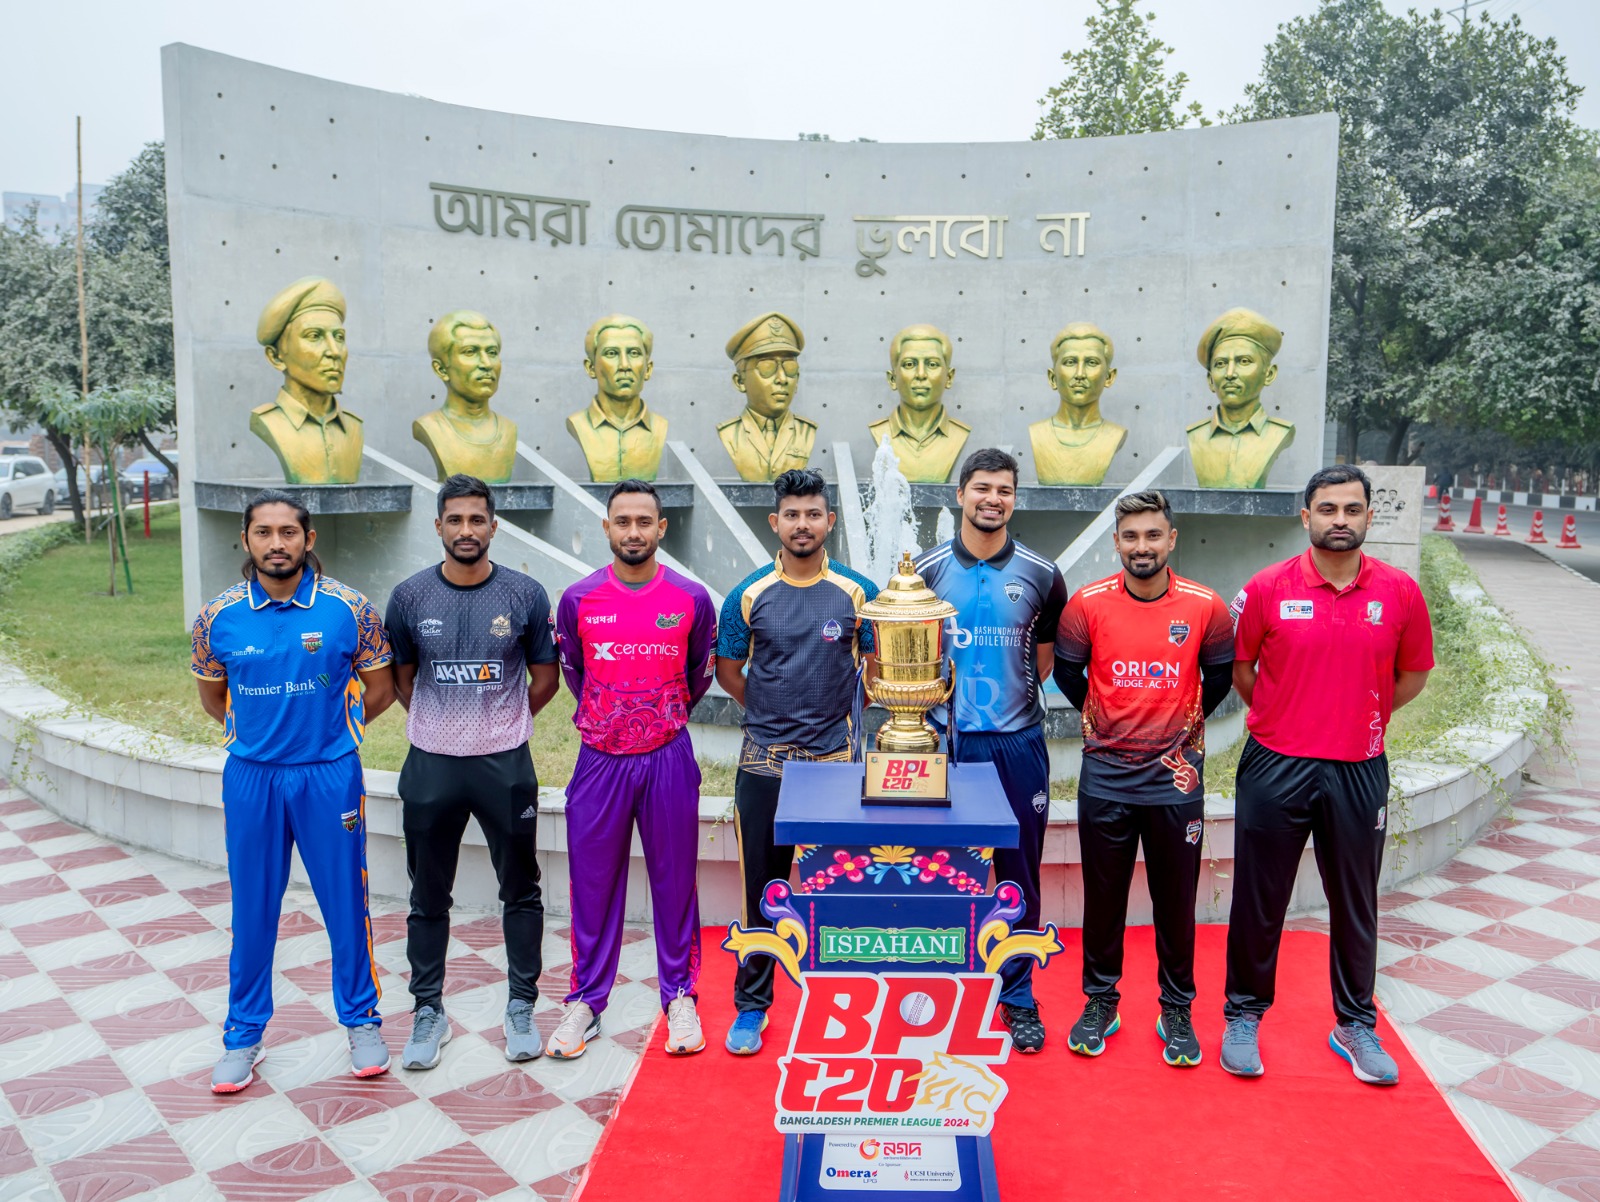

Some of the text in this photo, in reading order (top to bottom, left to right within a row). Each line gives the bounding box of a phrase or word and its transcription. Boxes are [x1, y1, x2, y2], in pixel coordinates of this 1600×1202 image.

[429, 182, 1090, 277] আমরা তোমাদের ভুলবো না
[974, 626, 1023, 636] BASHUNDHARA
[974, 635, 1021, 647] TOILETRIES
[436, 662, 501, 684] AKHTAR
[1111, 660, 1180, 677] ORION
[237, 679, 316, 696] Premier Bank
[477, 684, 503, 694] group
[885, 759, 930, 778] BPL
[826, 934, 959, 955] ISPAHANI
[793, 976, 1005, 1057] BPL
[780, 1116, 970, 1127] BANGLADESH PREMIER LEAGUE 2024
[883, 1142, 922, 1156] নগদ
[826, 1167, 872, 1178] Omera
[926, 1170, 954, 1179] University
